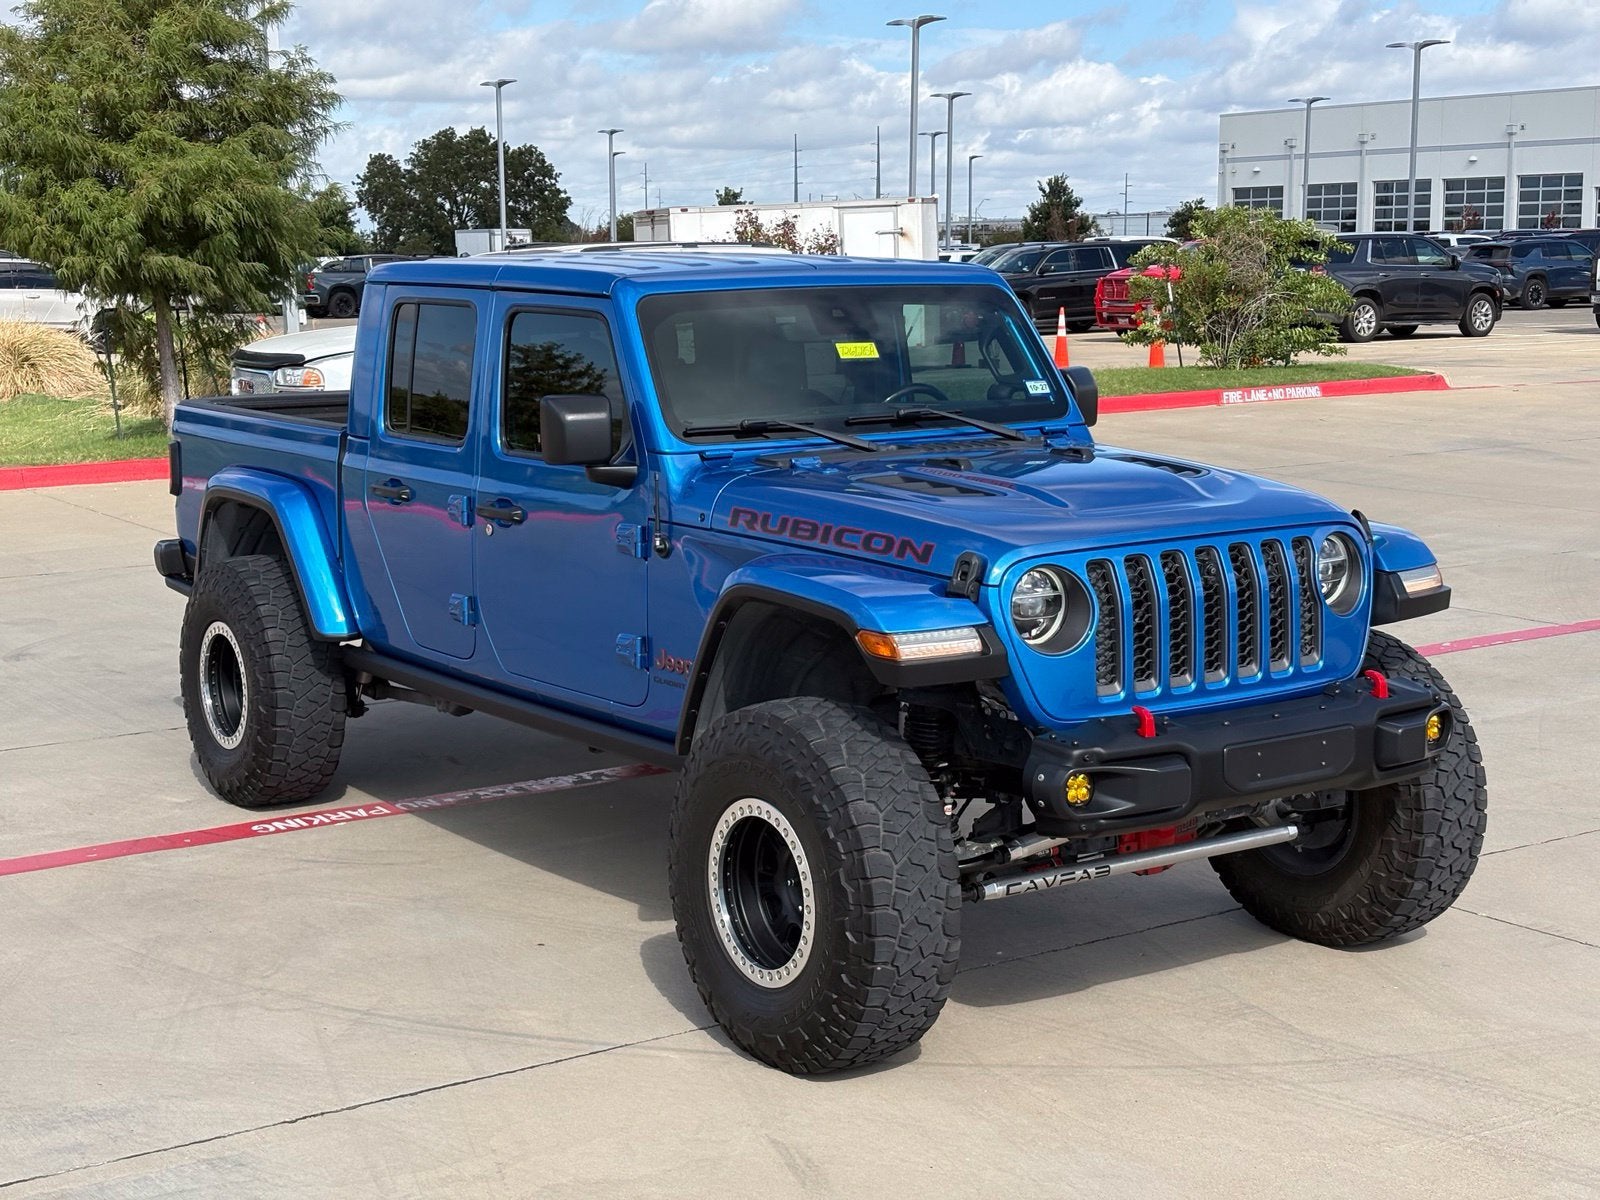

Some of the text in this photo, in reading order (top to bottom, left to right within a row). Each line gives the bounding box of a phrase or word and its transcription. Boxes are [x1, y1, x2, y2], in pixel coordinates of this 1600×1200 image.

[1222, 386, 1321, 404] FIRE LANE NO PARKING
[728, 506, 936, 564] RUBICON
[251, 805, 392, 833] PARKING
